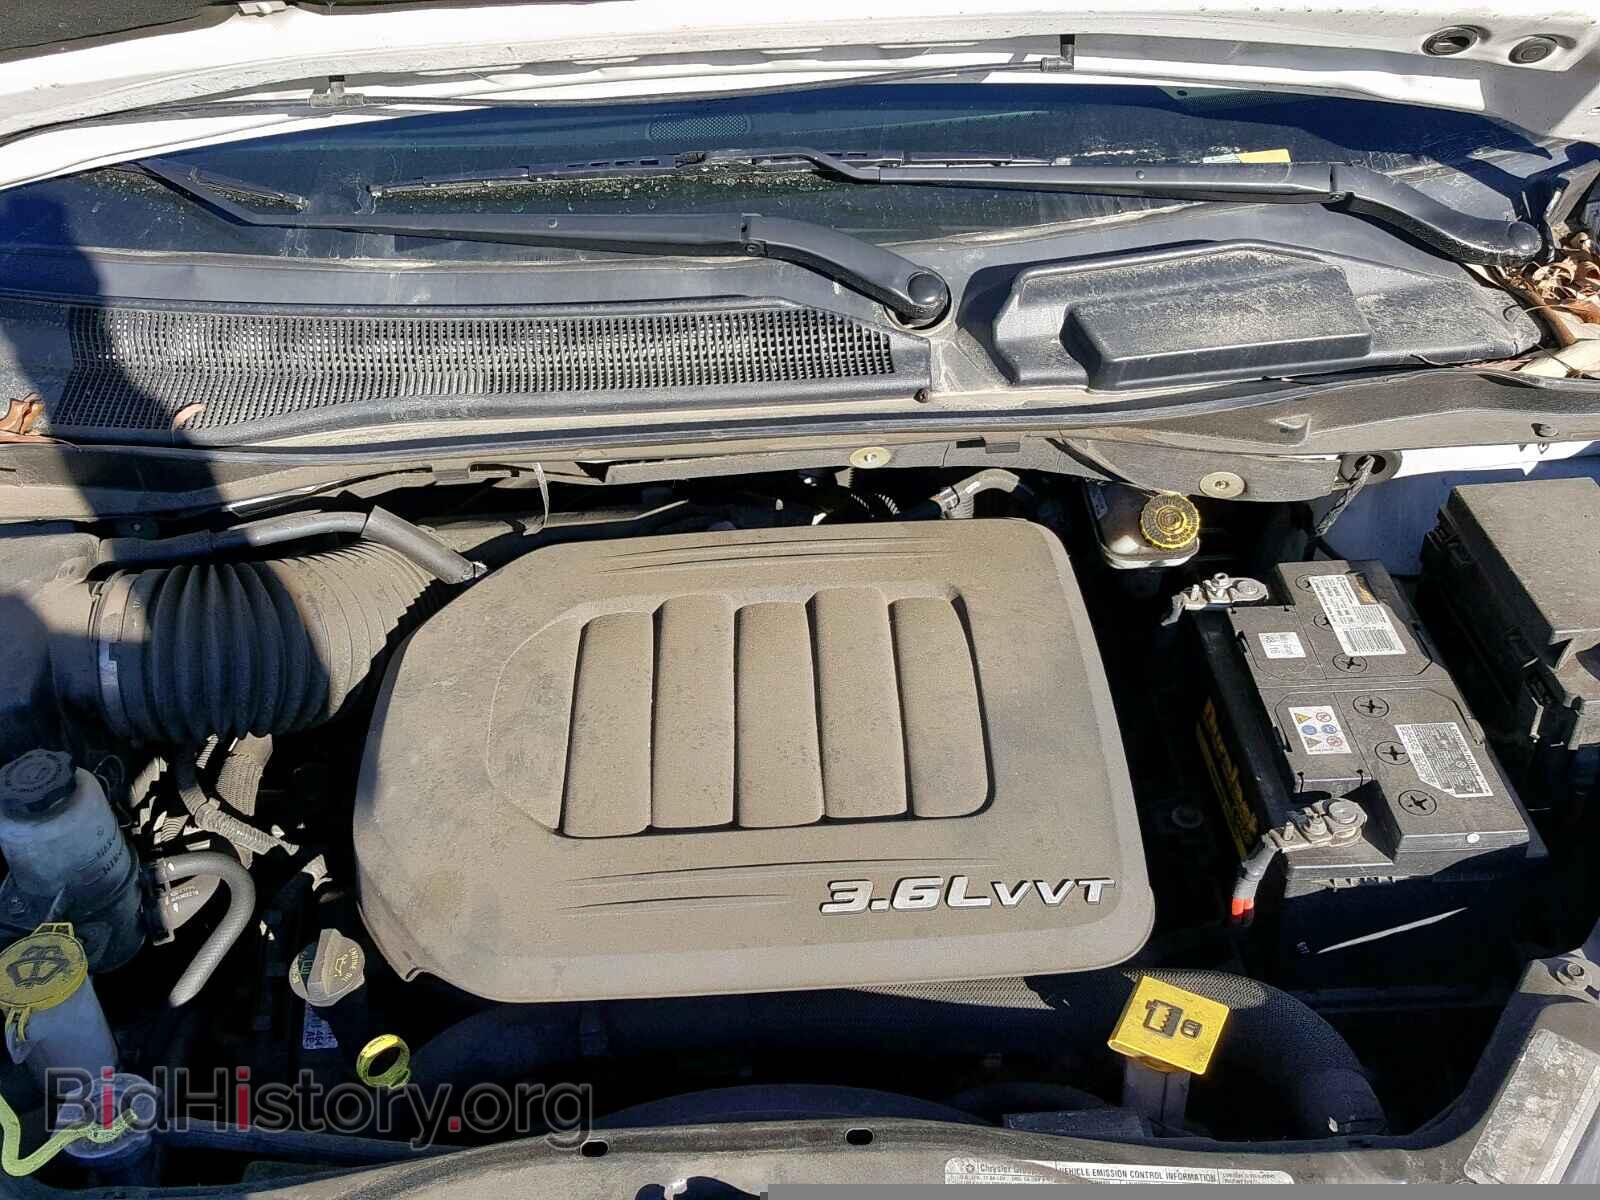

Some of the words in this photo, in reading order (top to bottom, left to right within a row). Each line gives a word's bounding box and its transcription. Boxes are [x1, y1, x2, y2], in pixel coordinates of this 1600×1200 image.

[1059, 1166, 1091, 1177] VEHICLE
[1092, 1168, 1127, 1178] EMISSION
[1129, 1169, 1164, 1180] CONTROL
[1165, 1171, 1217, 1182] INFORMATION
